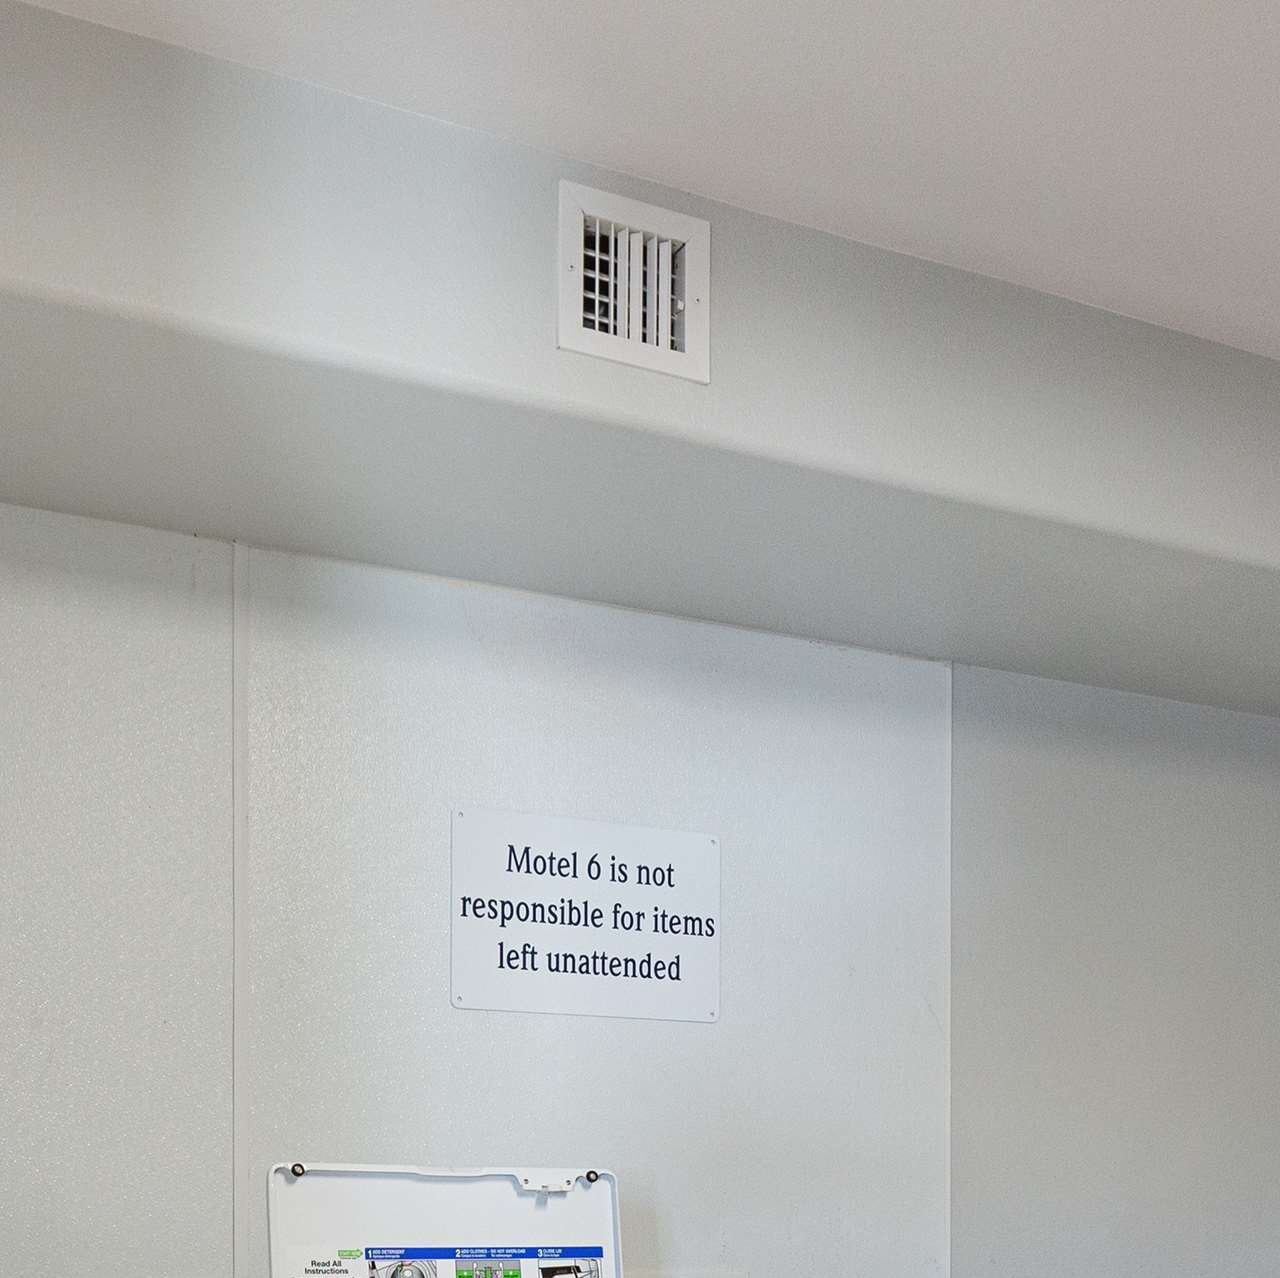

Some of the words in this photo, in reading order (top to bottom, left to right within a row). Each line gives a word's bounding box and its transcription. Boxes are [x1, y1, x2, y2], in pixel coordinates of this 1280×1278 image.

[505, 844, 579, 879] Motel
[587, 853, 601, 881] 6
[610, 855, 628, 884] is
[636, 863, 675, 888] not
[460, 895, 604, 928] responsible
[612, 903, 645, 932] for
[652, 906, 716, 937] items
[497, 942, 538, 971] left
[546, 949, 682, 981] unattended
[456, 1249, 461, 1258] 2
[538, 1249, 543, 1257] 3
